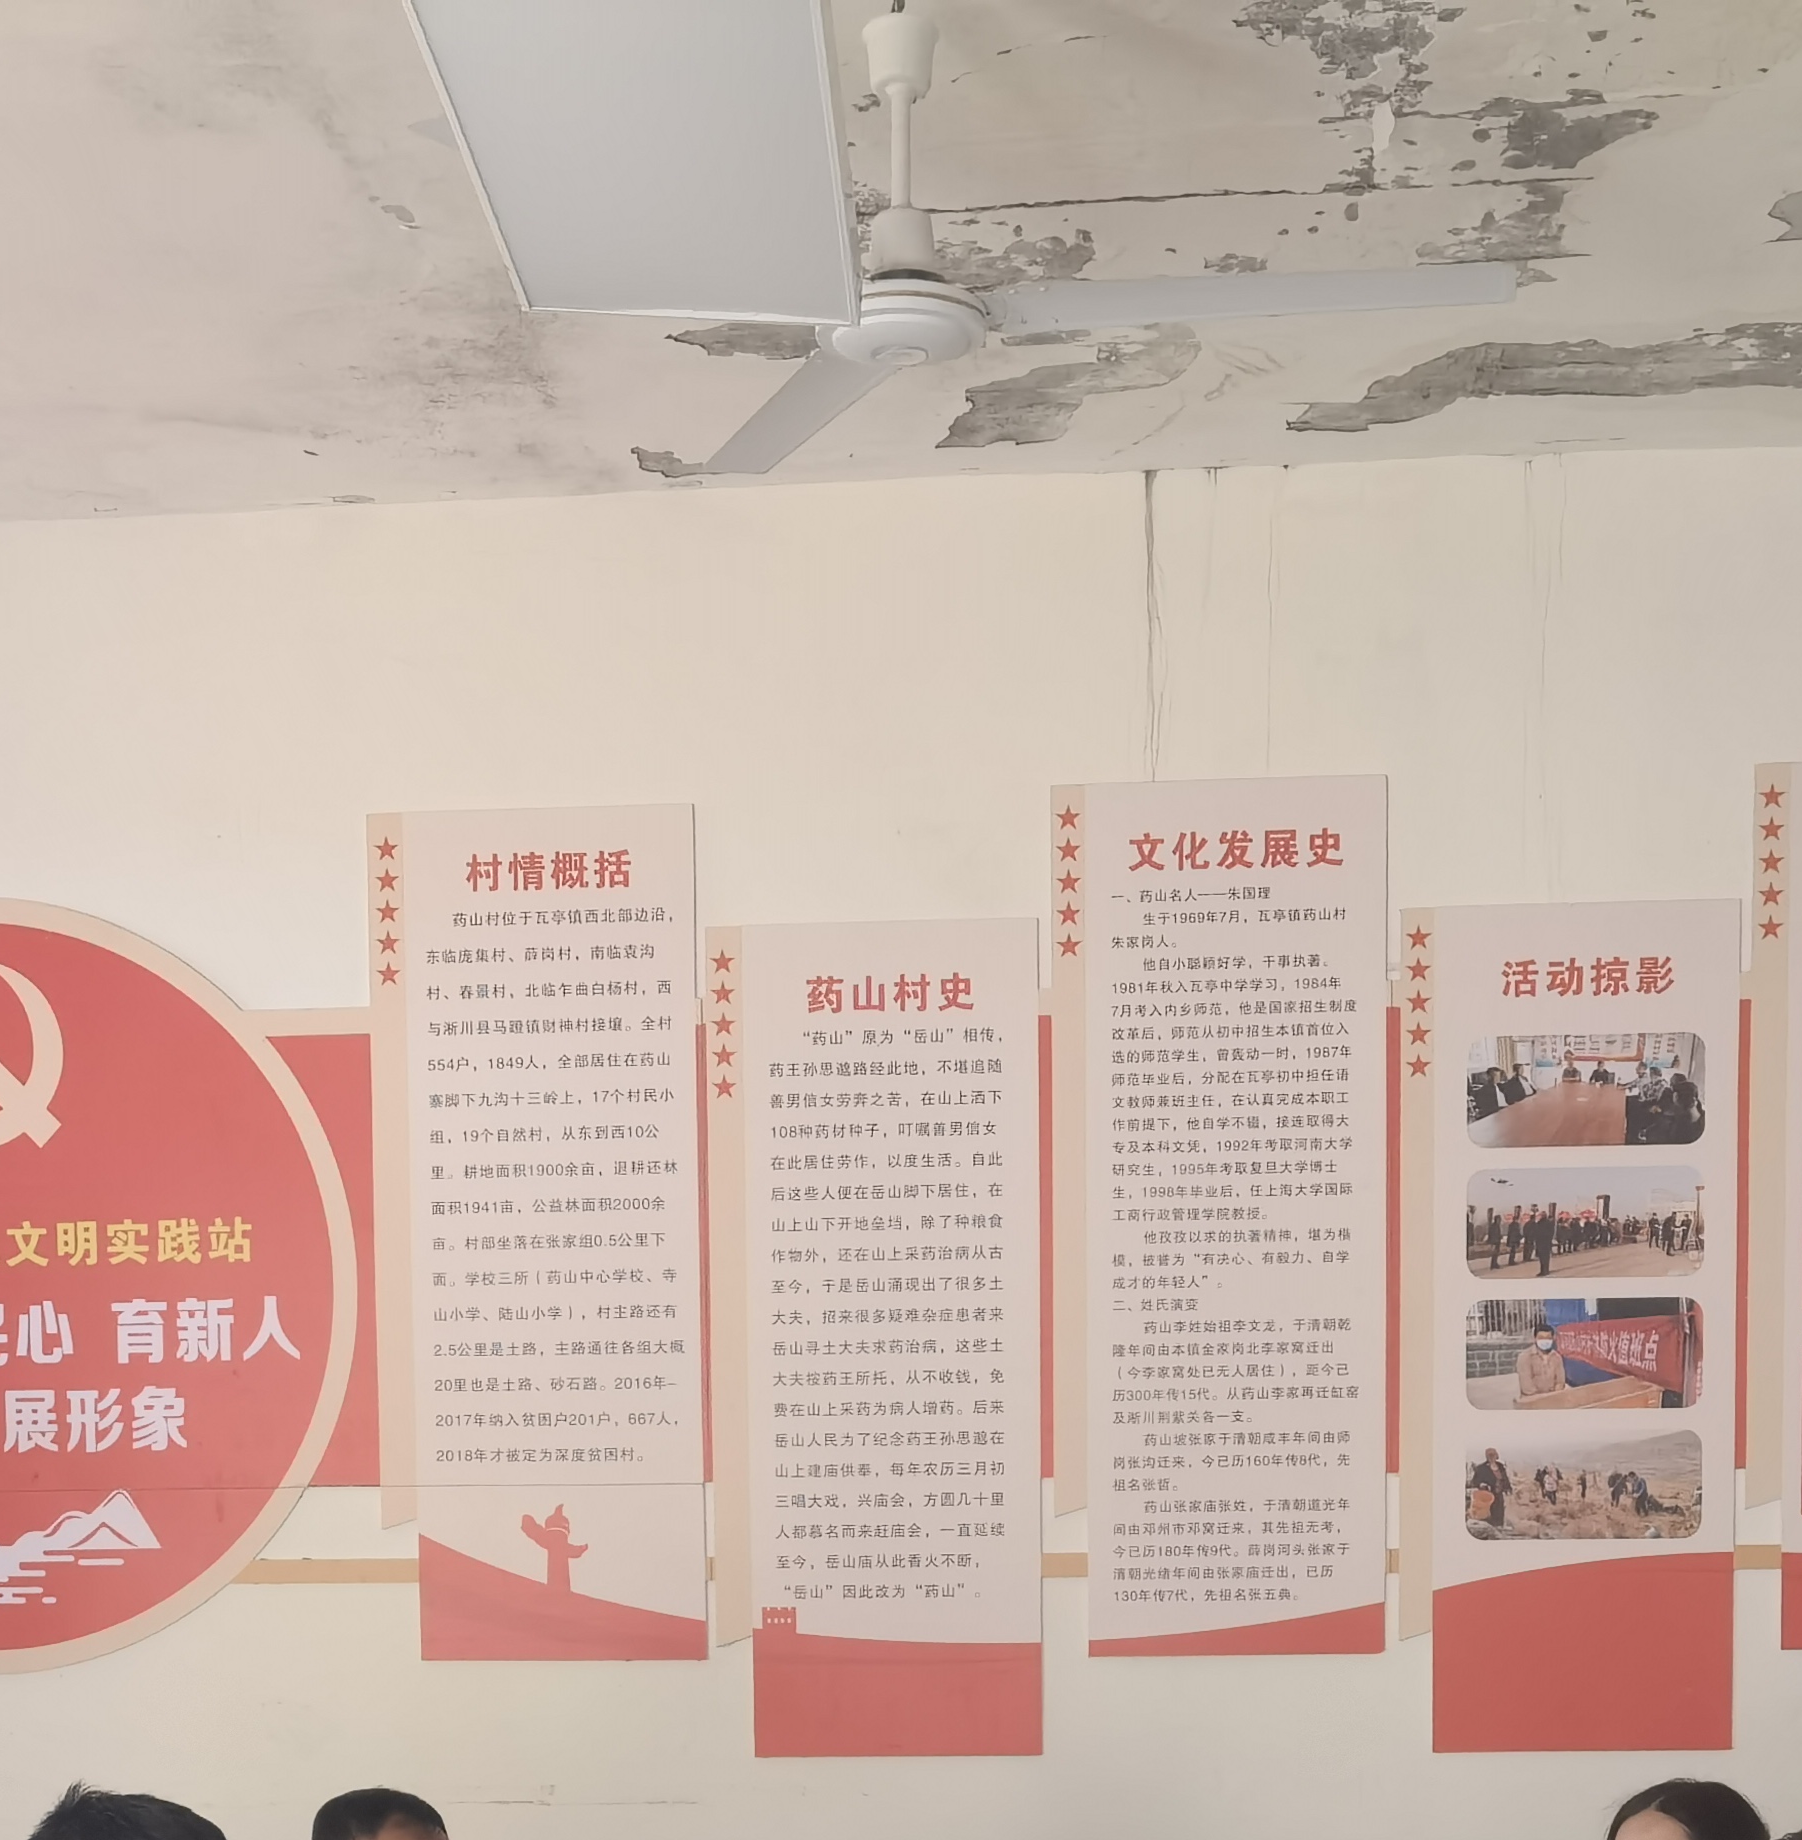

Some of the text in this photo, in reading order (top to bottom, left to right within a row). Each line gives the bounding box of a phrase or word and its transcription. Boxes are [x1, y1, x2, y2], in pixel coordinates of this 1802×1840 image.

[1129, 827, 1344, 872] 文化发展史
[466, 849, 632, 892] 村情概括
[1111, 934, 1177, 950] 朱家岗人。
[1502, 956, 1675, 997] 活动掠影
[806, 972, 974, 1013] 药山村史
[428, 1052, 671, 1072] 554户，1849人，全部居住在药山
[770, 1150, 1003, 1171] 在此居住劳作，以度生活。自此
[771, 1182, 1003, 1202] 后这些人便在岳山脚下居住，在
[431, 1196, 666, 1216] 面积1941亩，公益林面积2000余
[1112, 1206, 1268, 1222] 工商行政管理学院教授。
[771, 1244, 1003, 1264] 作物外，还在山上采药治病从古
[771, 1276, 1004, 1294] 至今，于是岳山涌现出了很多土
[1113, 1297, 1198, 1312] 二、姓氏演变
[771, 1306, 1004, 1326] 大夫，招来很多疑难杂症患者来
[109, 1295, 301, 1365] 育新人
[771, 1338, 1004, 1356] 岳山寻土大夫求药治病，这些土
[2, 1385, 188, 1455] 展形象
[774, 1430, 1005, 1449] 岳山人民为了纪念药王孙思邈在
[436, 1447, 647, 1463] 2018年才被定为深度贫困村。
[1112, 1478, 1178, 1492] 祖名张哲。
[776, 1521, 1005, 1540] 人都慕名而来赶庙会，一直延续
